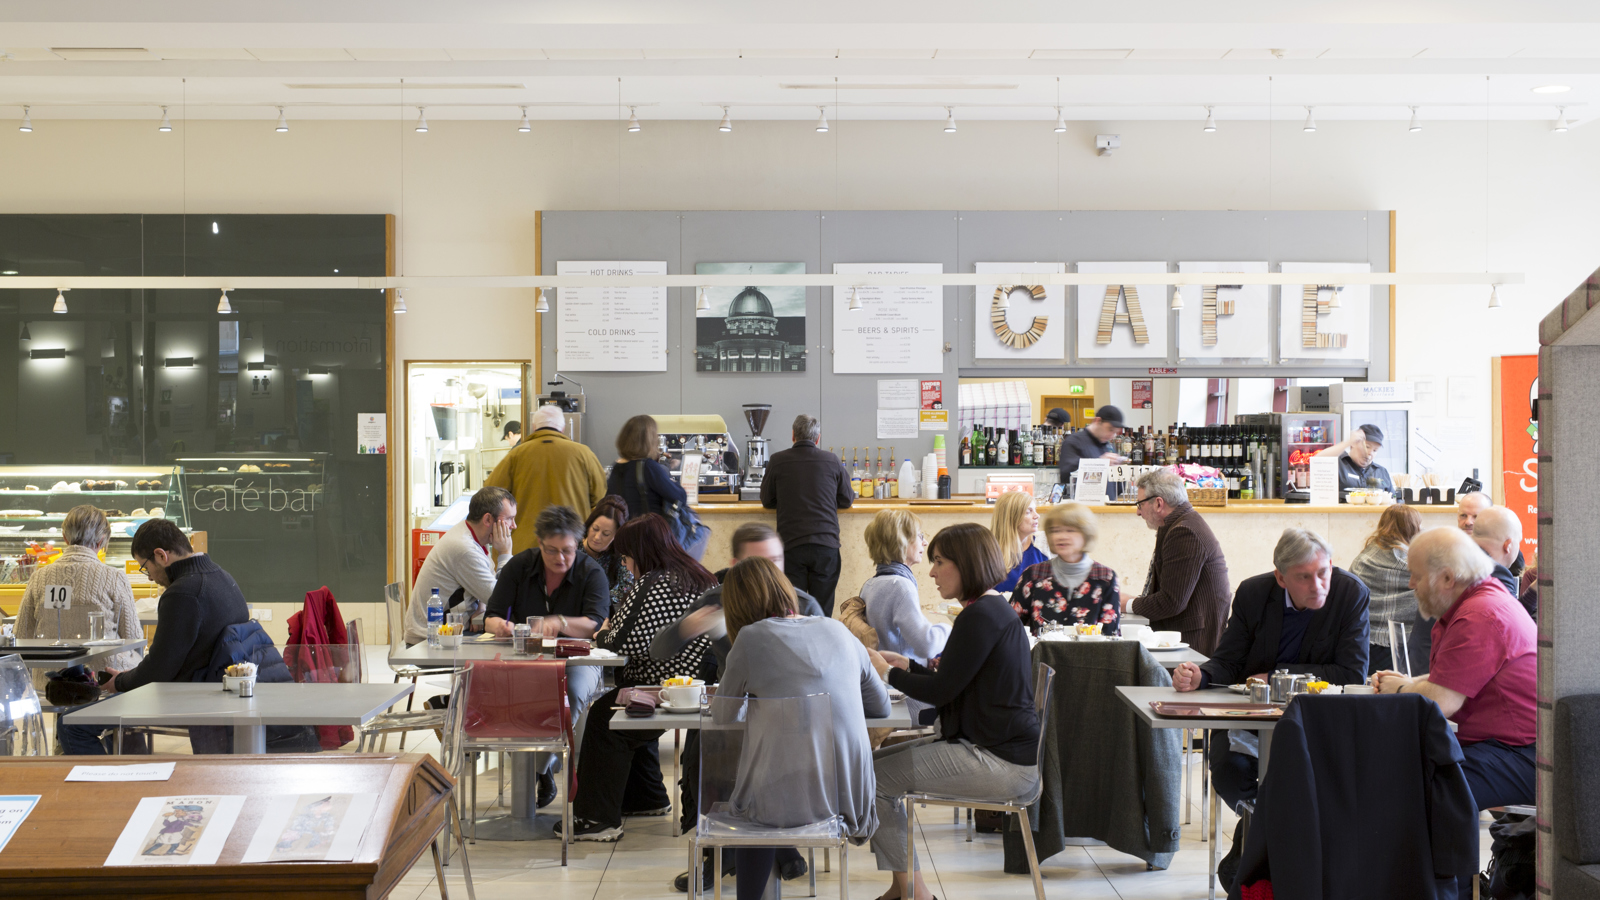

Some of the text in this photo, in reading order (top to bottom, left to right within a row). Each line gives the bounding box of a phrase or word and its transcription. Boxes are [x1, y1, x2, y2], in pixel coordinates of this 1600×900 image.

[588, 328, 636, 336] COLD DRINKS
[1117, 466, 1123, 476] 9
[193, 478, 322, 512] café bar
[50, 587, 67, 603] 10
